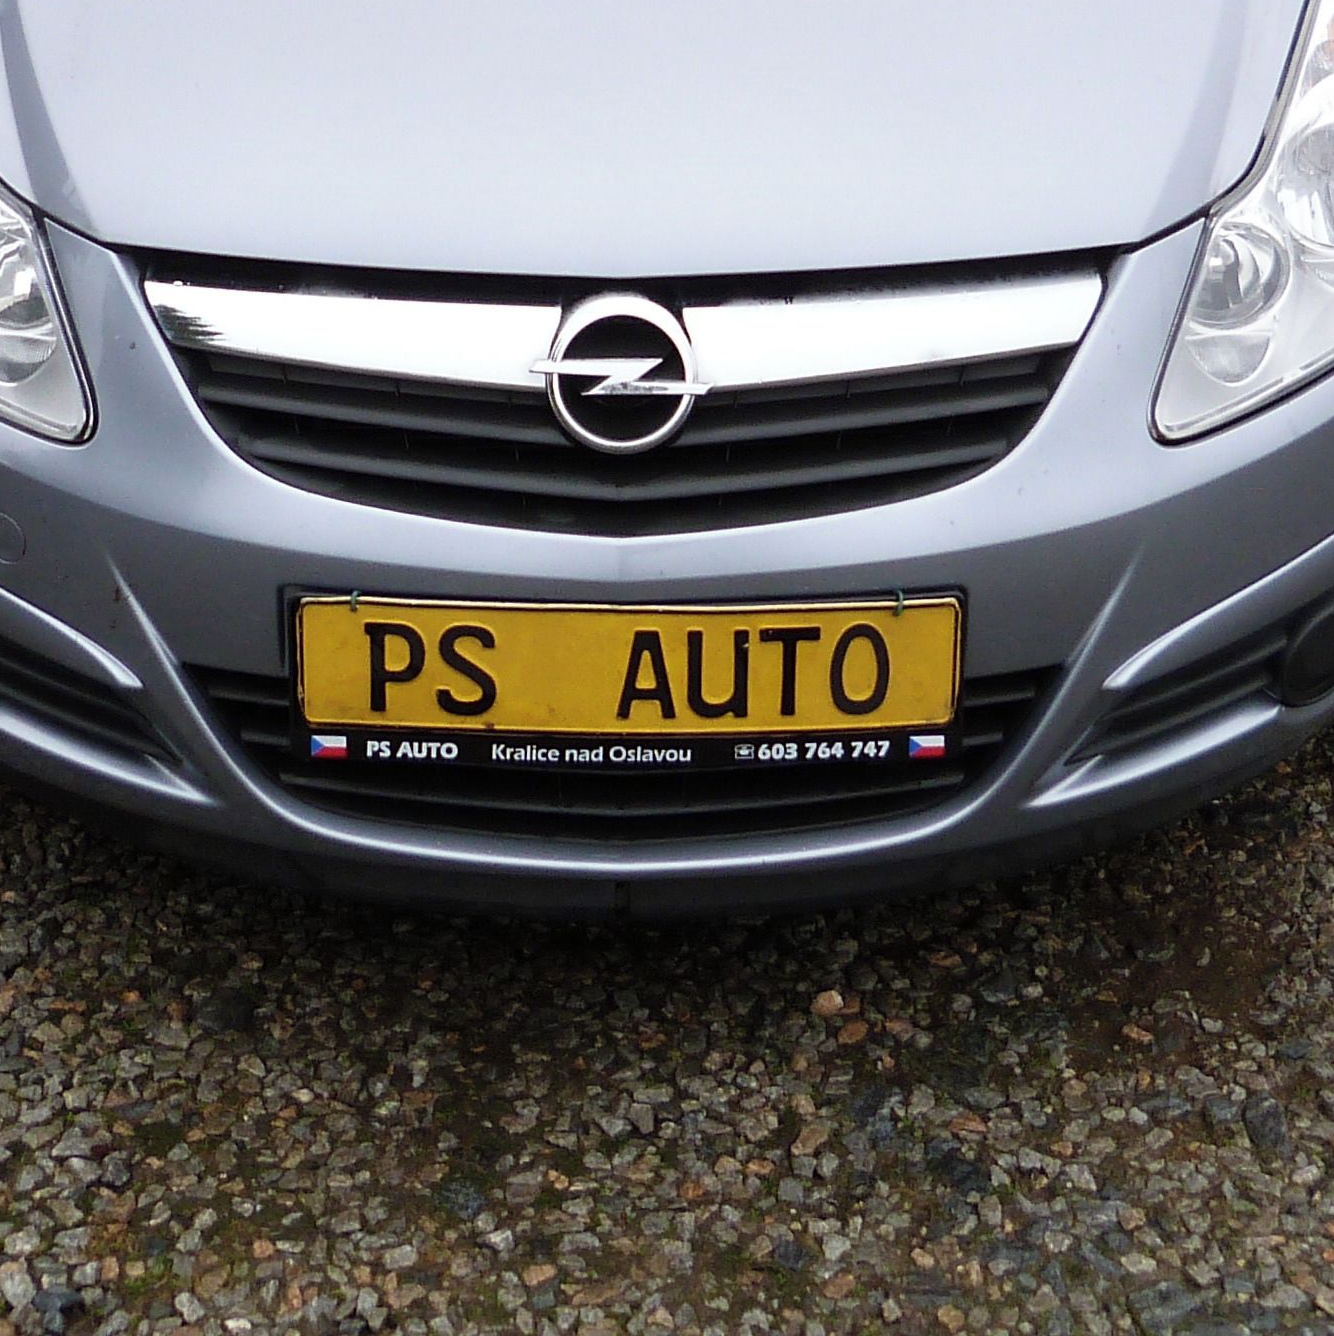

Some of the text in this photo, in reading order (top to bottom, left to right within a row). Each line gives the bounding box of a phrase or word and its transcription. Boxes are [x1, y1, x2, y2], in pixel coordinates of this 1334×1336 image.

[364, 621, 891, 720] PS AUTO
[366, 740, 459, 760] PS AUTO
[491, 743, 692, 763] Kralice nad Oslavou
[757, 740, 891, 760] 603 764 747
